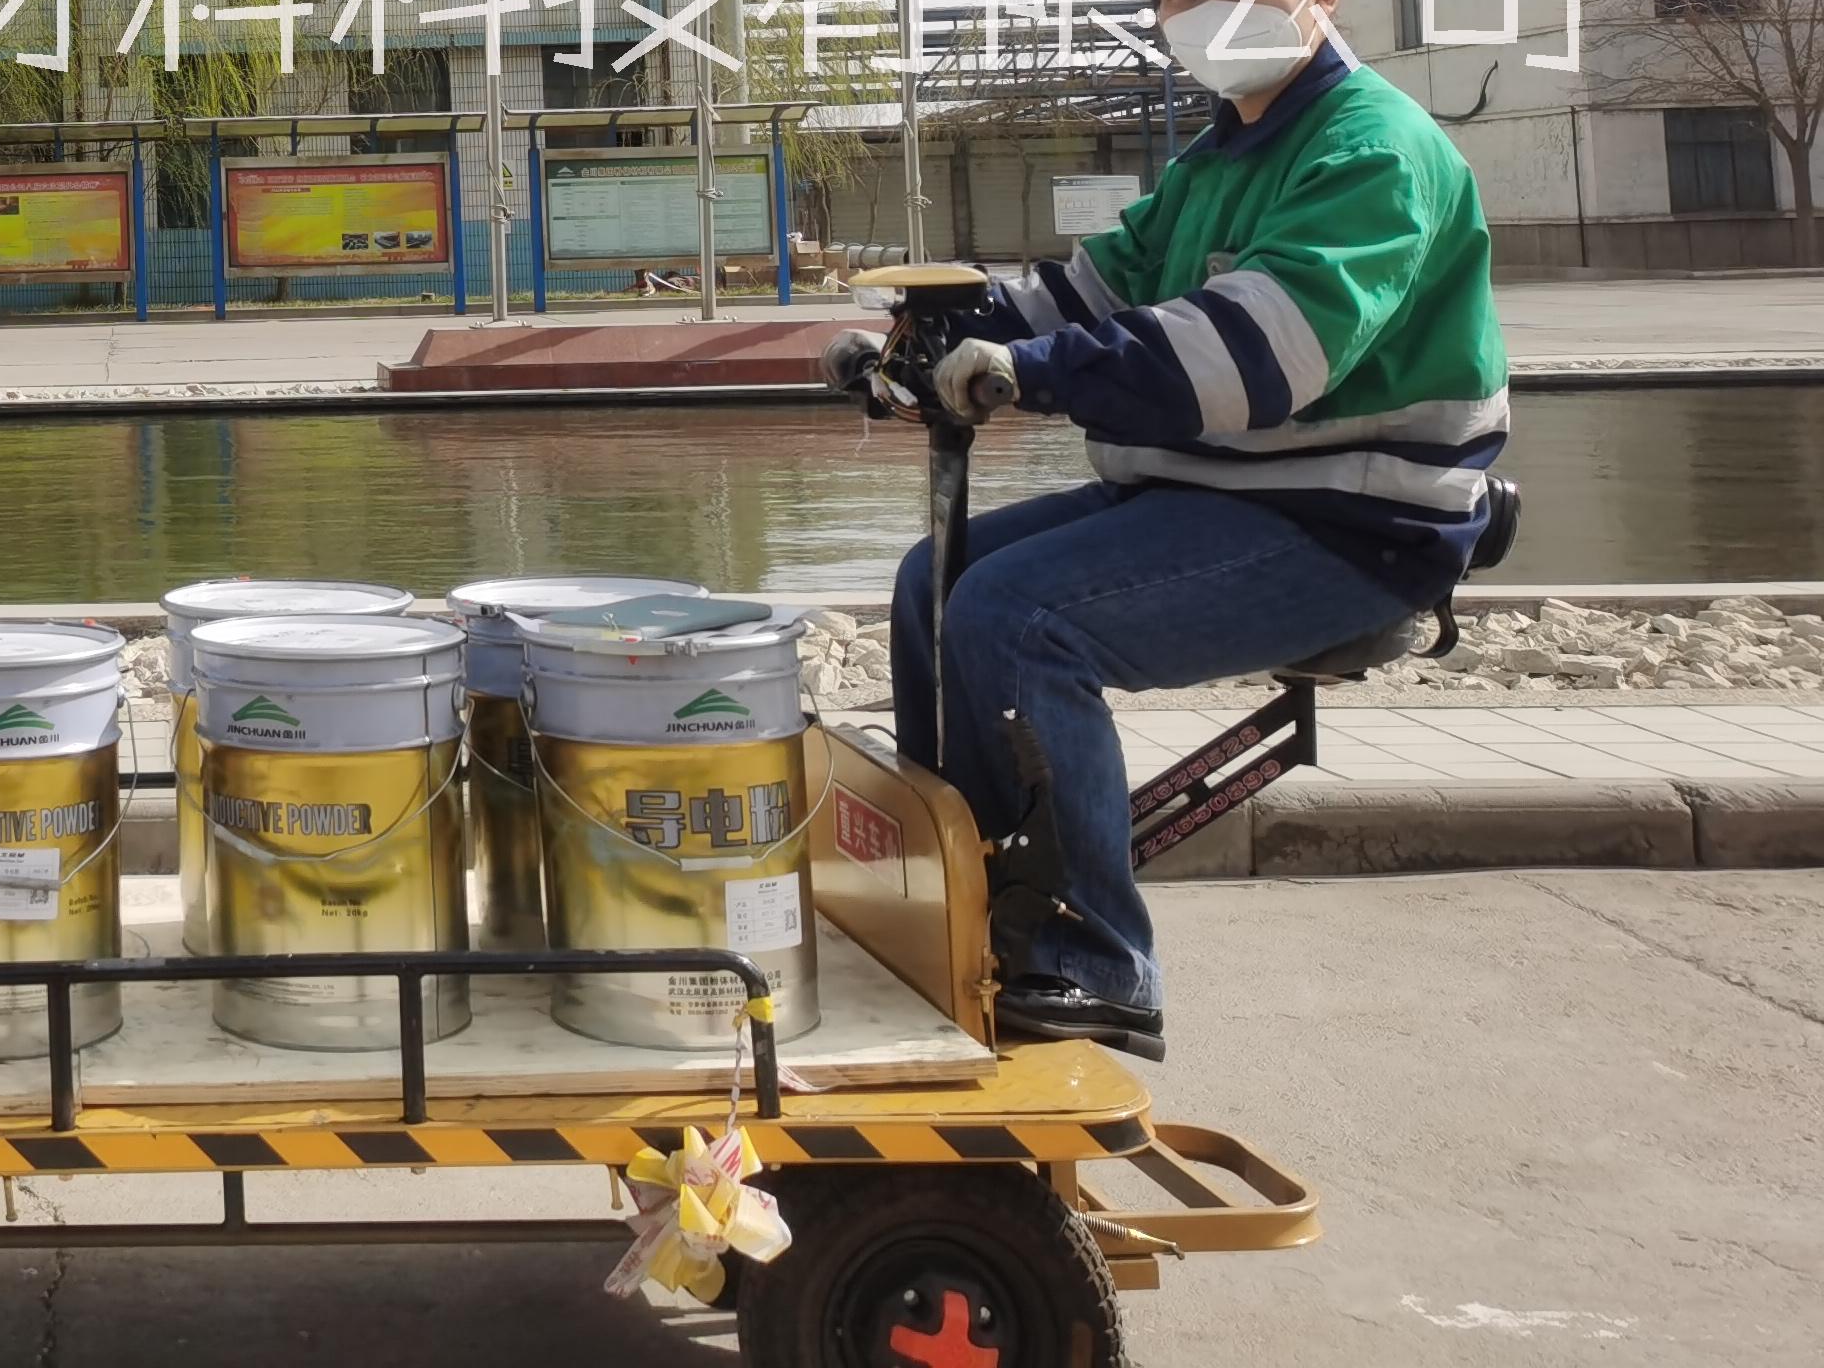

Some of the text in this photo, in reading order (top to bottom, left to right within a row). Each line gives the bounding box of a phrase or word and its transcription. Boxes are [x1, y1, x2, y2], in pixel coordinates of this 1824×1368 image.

[227, 724, 282, 739] JINCHUAN
[665, 721, 734, 733] JINCHUAN
[209, 792, 372, 836] NDUCTIVE POWDER
[625, 780, 793, 849] 导电粉
